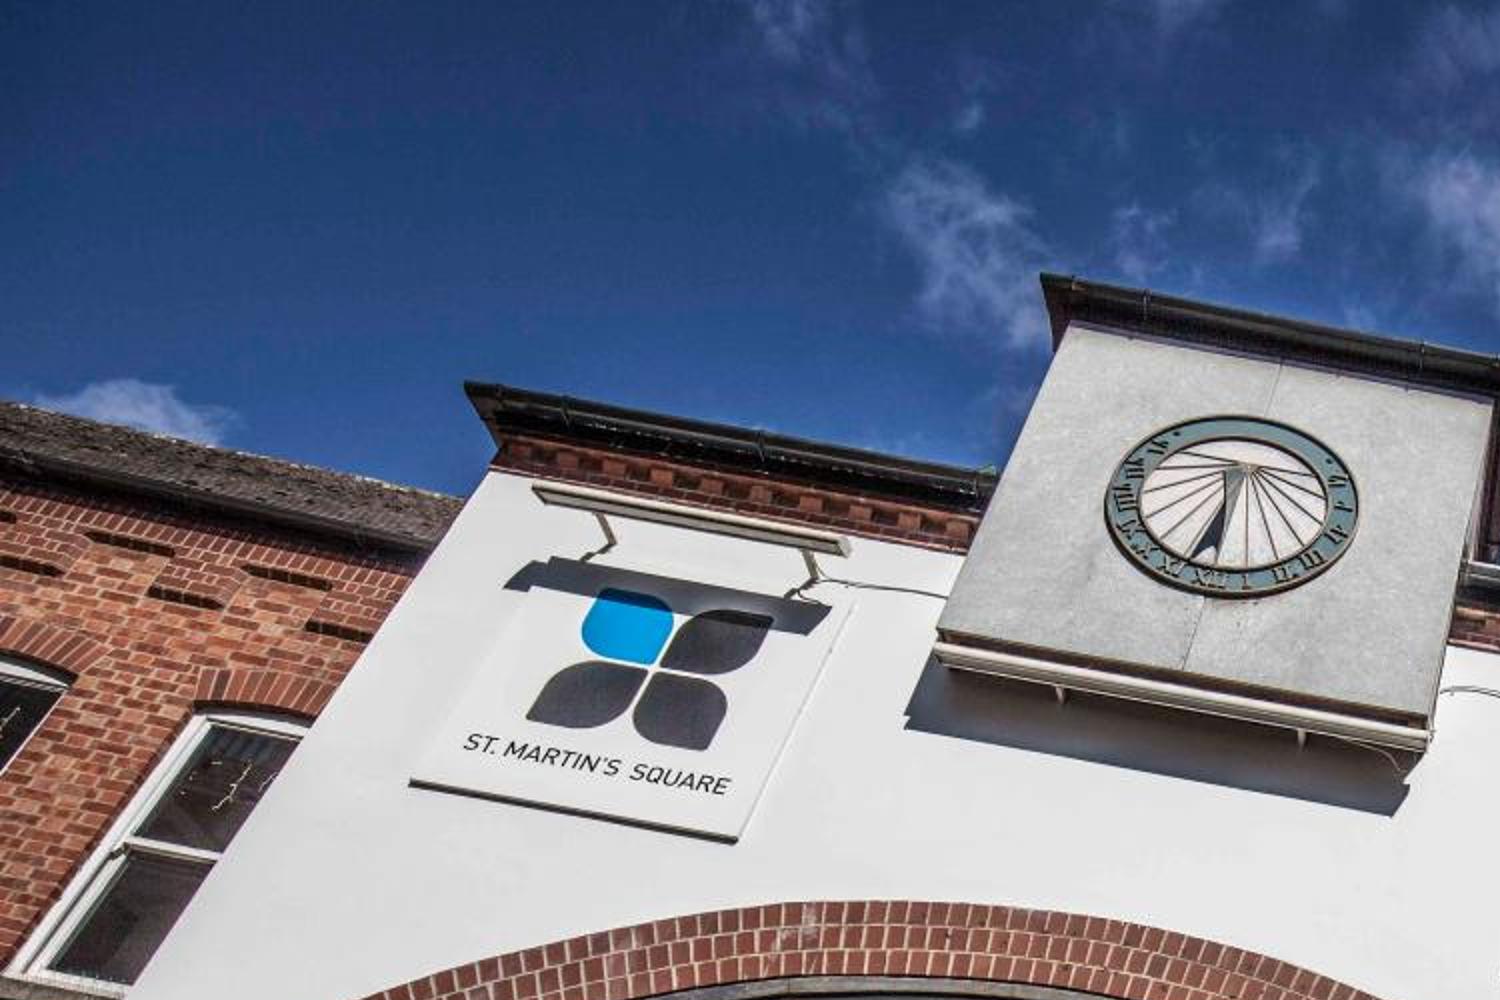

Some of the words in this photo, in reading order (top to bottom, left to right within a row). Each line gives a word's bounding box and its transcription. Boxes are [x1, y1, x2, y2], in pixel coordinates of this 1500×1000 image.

[463, 732, 499, 755] ST.
[503, 740, 622, 776] MARTIN'S
[629, 763, 732, 796] SQUARE
